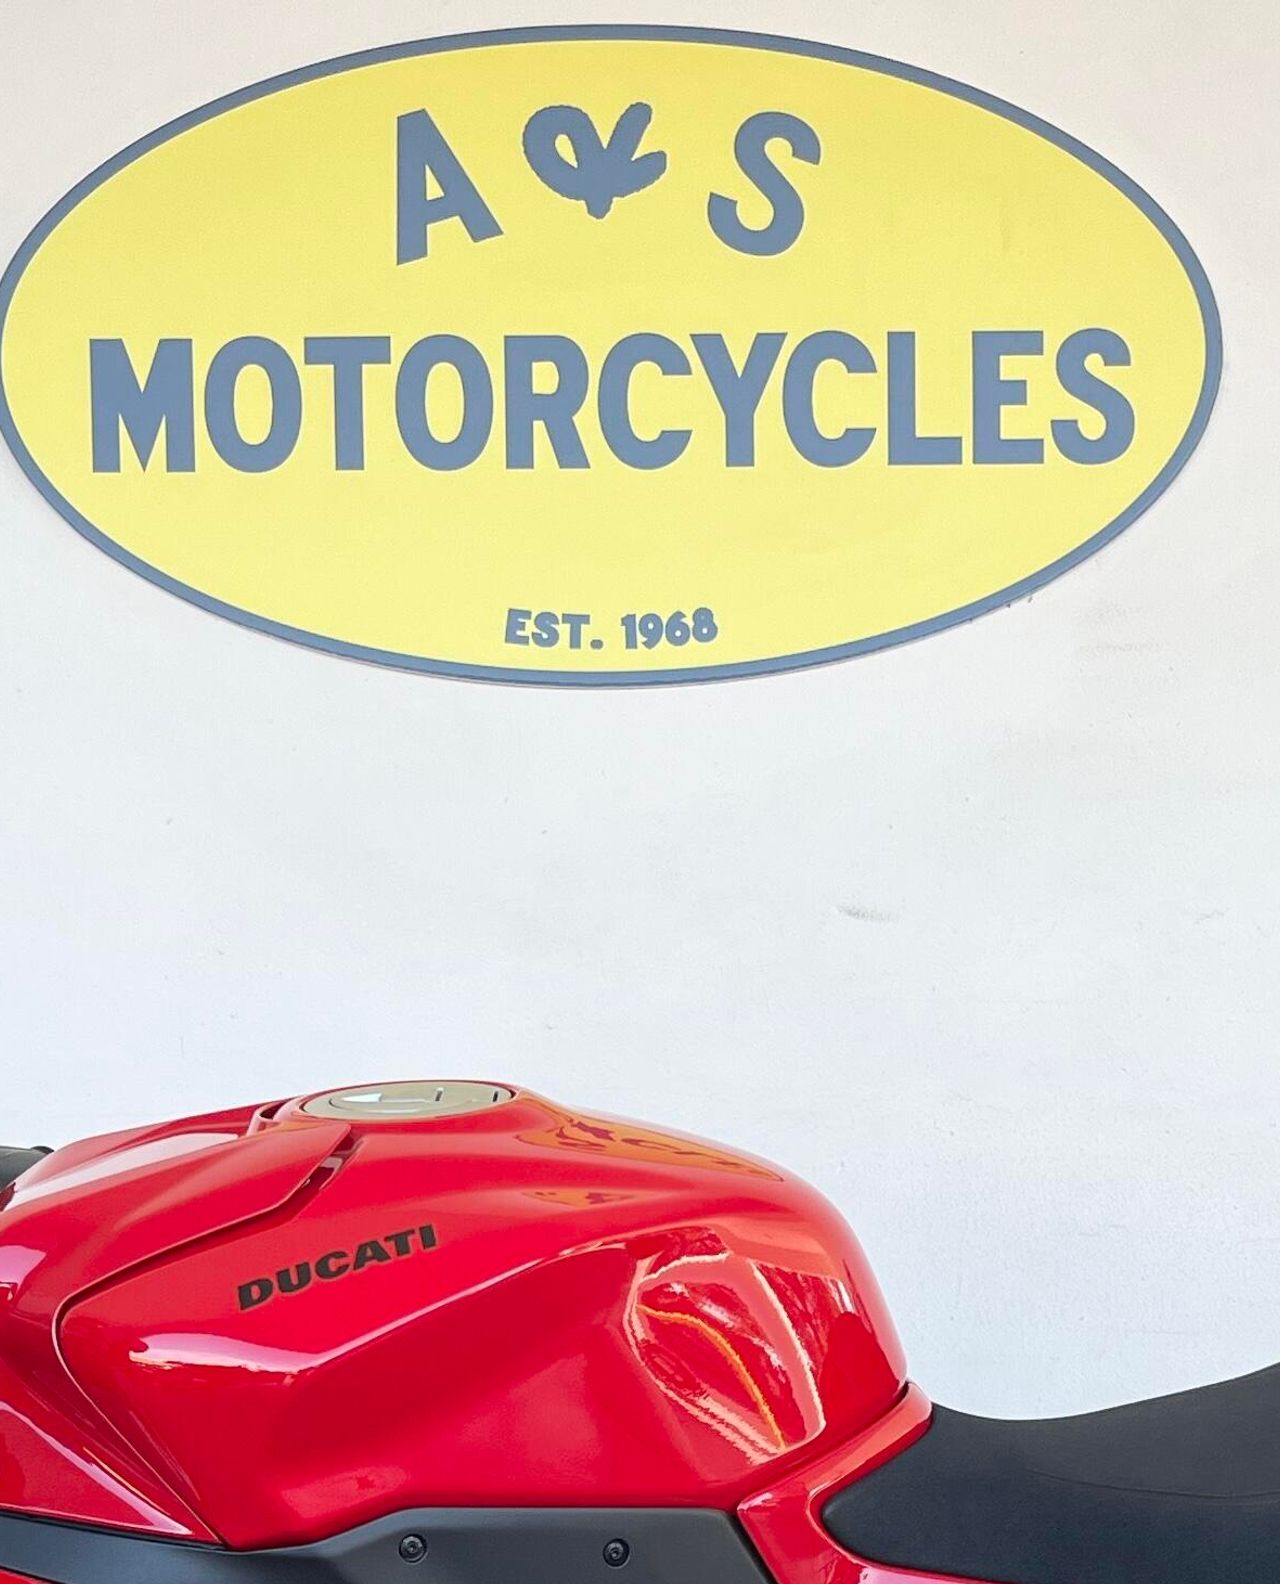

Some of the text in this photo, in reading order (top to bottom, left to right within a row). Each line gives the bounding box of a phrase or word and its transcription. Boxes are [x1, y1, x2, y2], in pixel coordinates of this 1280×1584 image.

[397, 107, 503, 266] A
[706, 110, 821, 257] S
[88, 327, 1136, 474] MOTORCYCLES
[504, 607, 719, 650] EST. 1968
[237, 1225, 436, 1310] DUCATI
